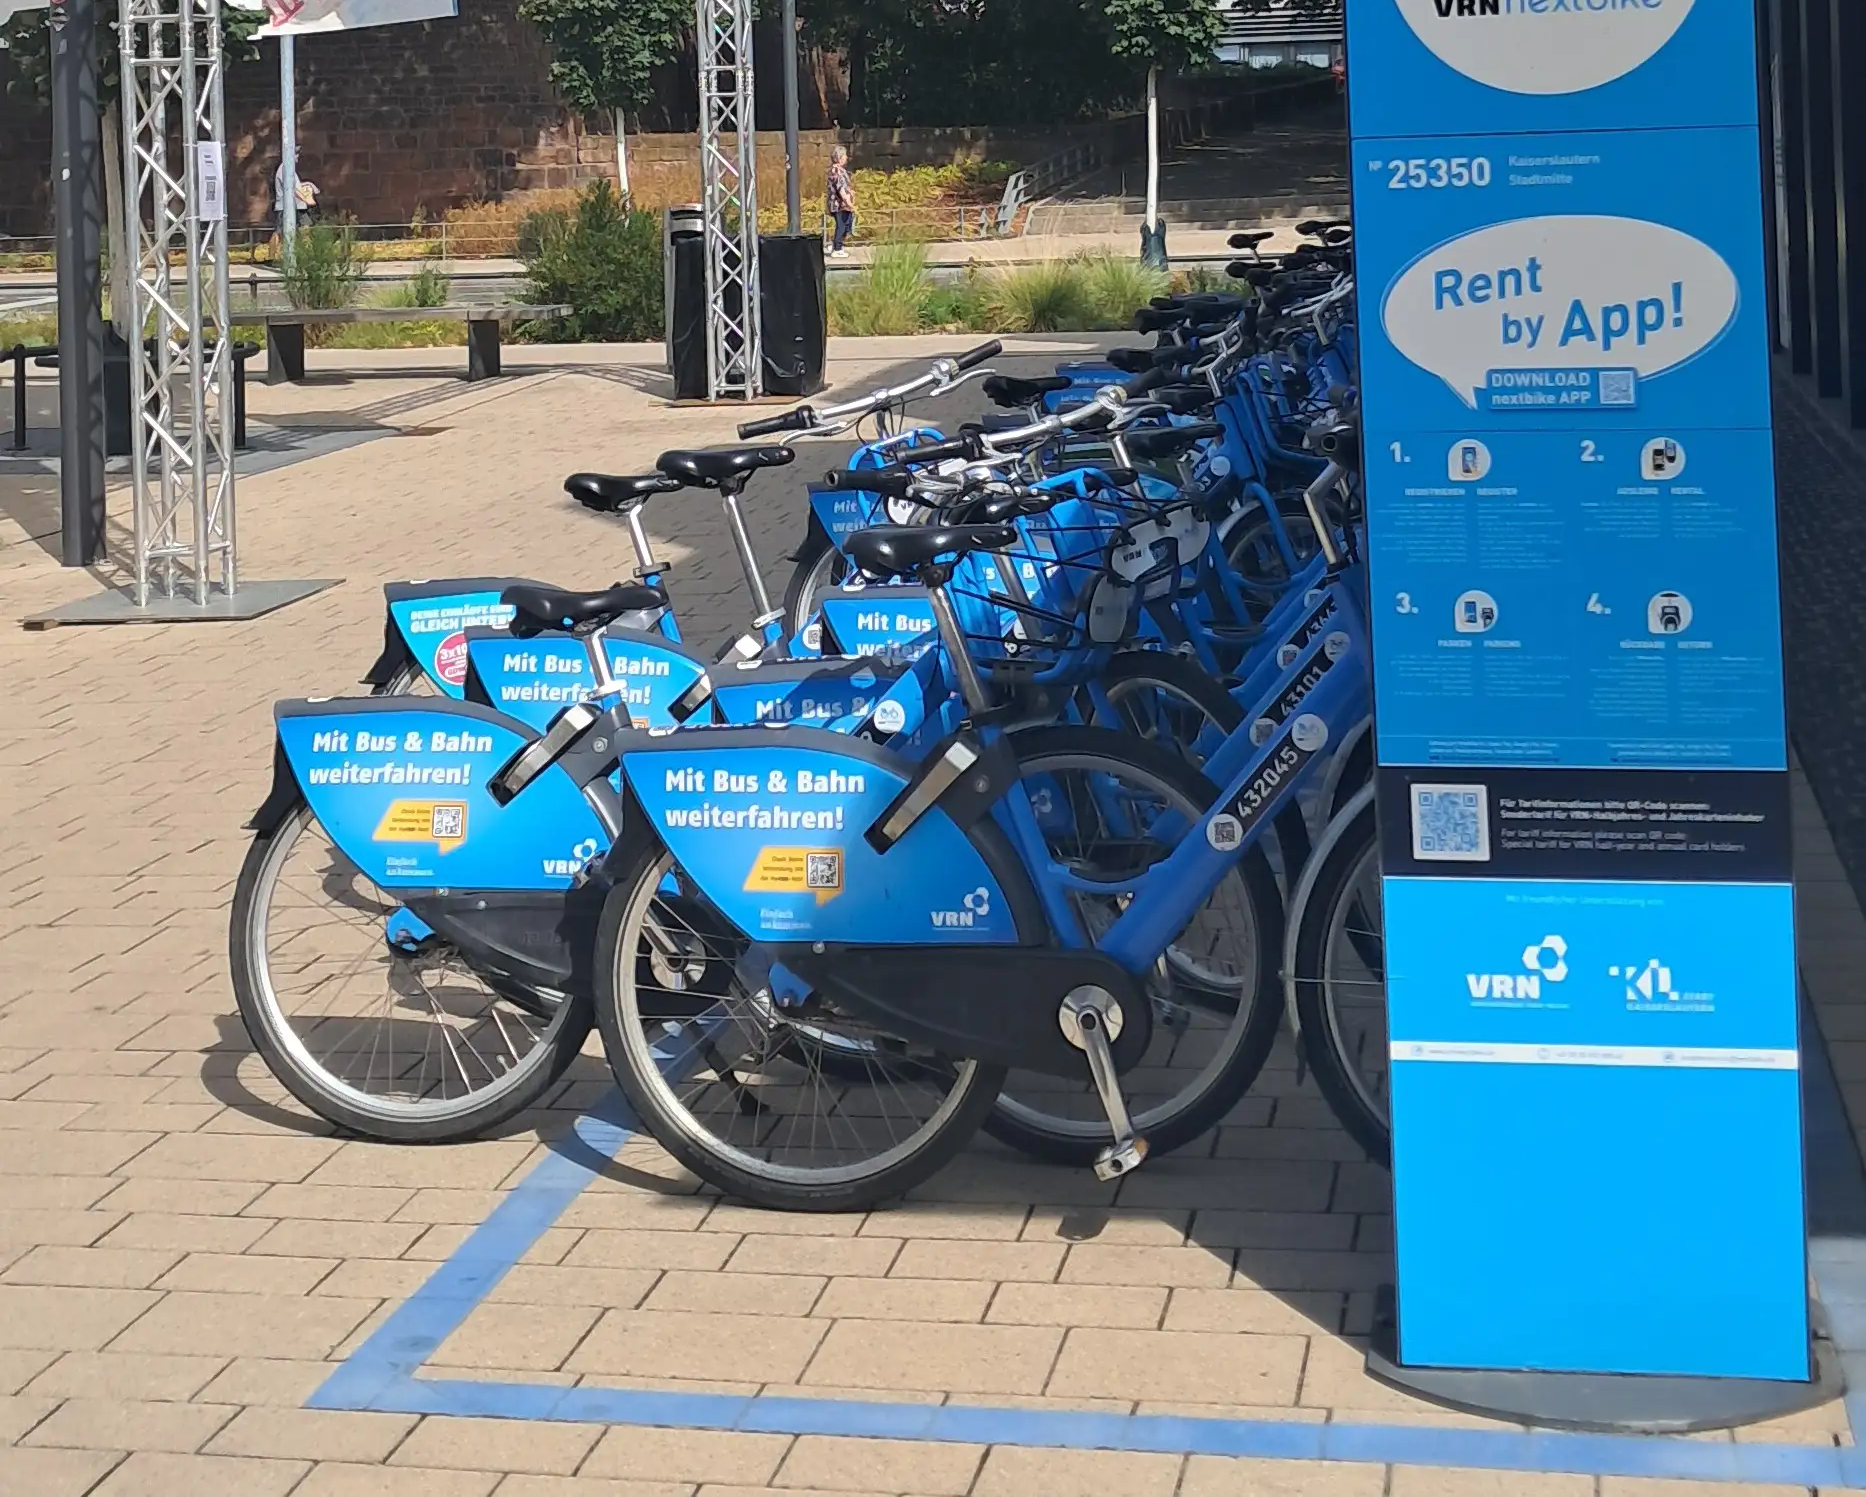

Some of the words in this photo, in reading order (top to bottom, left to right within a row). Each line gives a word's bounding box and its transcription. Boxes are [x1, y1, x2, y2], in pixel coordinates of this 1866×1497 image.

[1508, 154, 1601, 167] Kaiserslautern
[1387, 156, 1491, 190] 25350
[1508, 173, 1573, 186] Stadtmitte
[1434, 256, 1543, 311] Rent
[1502, 312, 1545, 350] by
[1558, 281, 1684, 352] App!
[1491, 372, 1591, 387] DOWNLOAD
[1491, 391, 1556, 405] nextbike
[1558, 391, 1592, 404] APP
[1388, 441, 1412, 463] 1.
[1579, 439, 1605, 462] 2.
[833, 499, 857, 514] Mit
[1395, 591, 1419, 615] 3.
[1585, 592, 1612, 615] 4.
[410, 616, 459, 634] GLEICH
[857, 612, 889, 631] Mit
[895, 613, 932, 633] Bus
[503, 652, 539, 673] Mit
[544, 654, 583, 674] Bus
[614, 656, 670, 676] Bahn
[501, 680, 651, 705] weiterfaen!
[756, 697, 794, 720] Mit
[801, 698, 844, 719] Bus
[312, 731, 349, 753] Mit
[355, 731, 397, 754] Bus
[403, 732, 423, 753] &
[430, 731, 493, 754] Bahn
[308, 761, 471, 786] weiterfahren!
[665, 769, 706, 794] Mit
[713, 770, 759, 794] Bus
[767, 771, 789, 794] &
[797, 770, 866, 794] Bahn
[1235, 745, 1299, 819] 432045
[665, 804, 845, 831] weiterfahren!
[930, 911, 974, 928] VRN
[1466, 973, 1541, 1000] VRN
